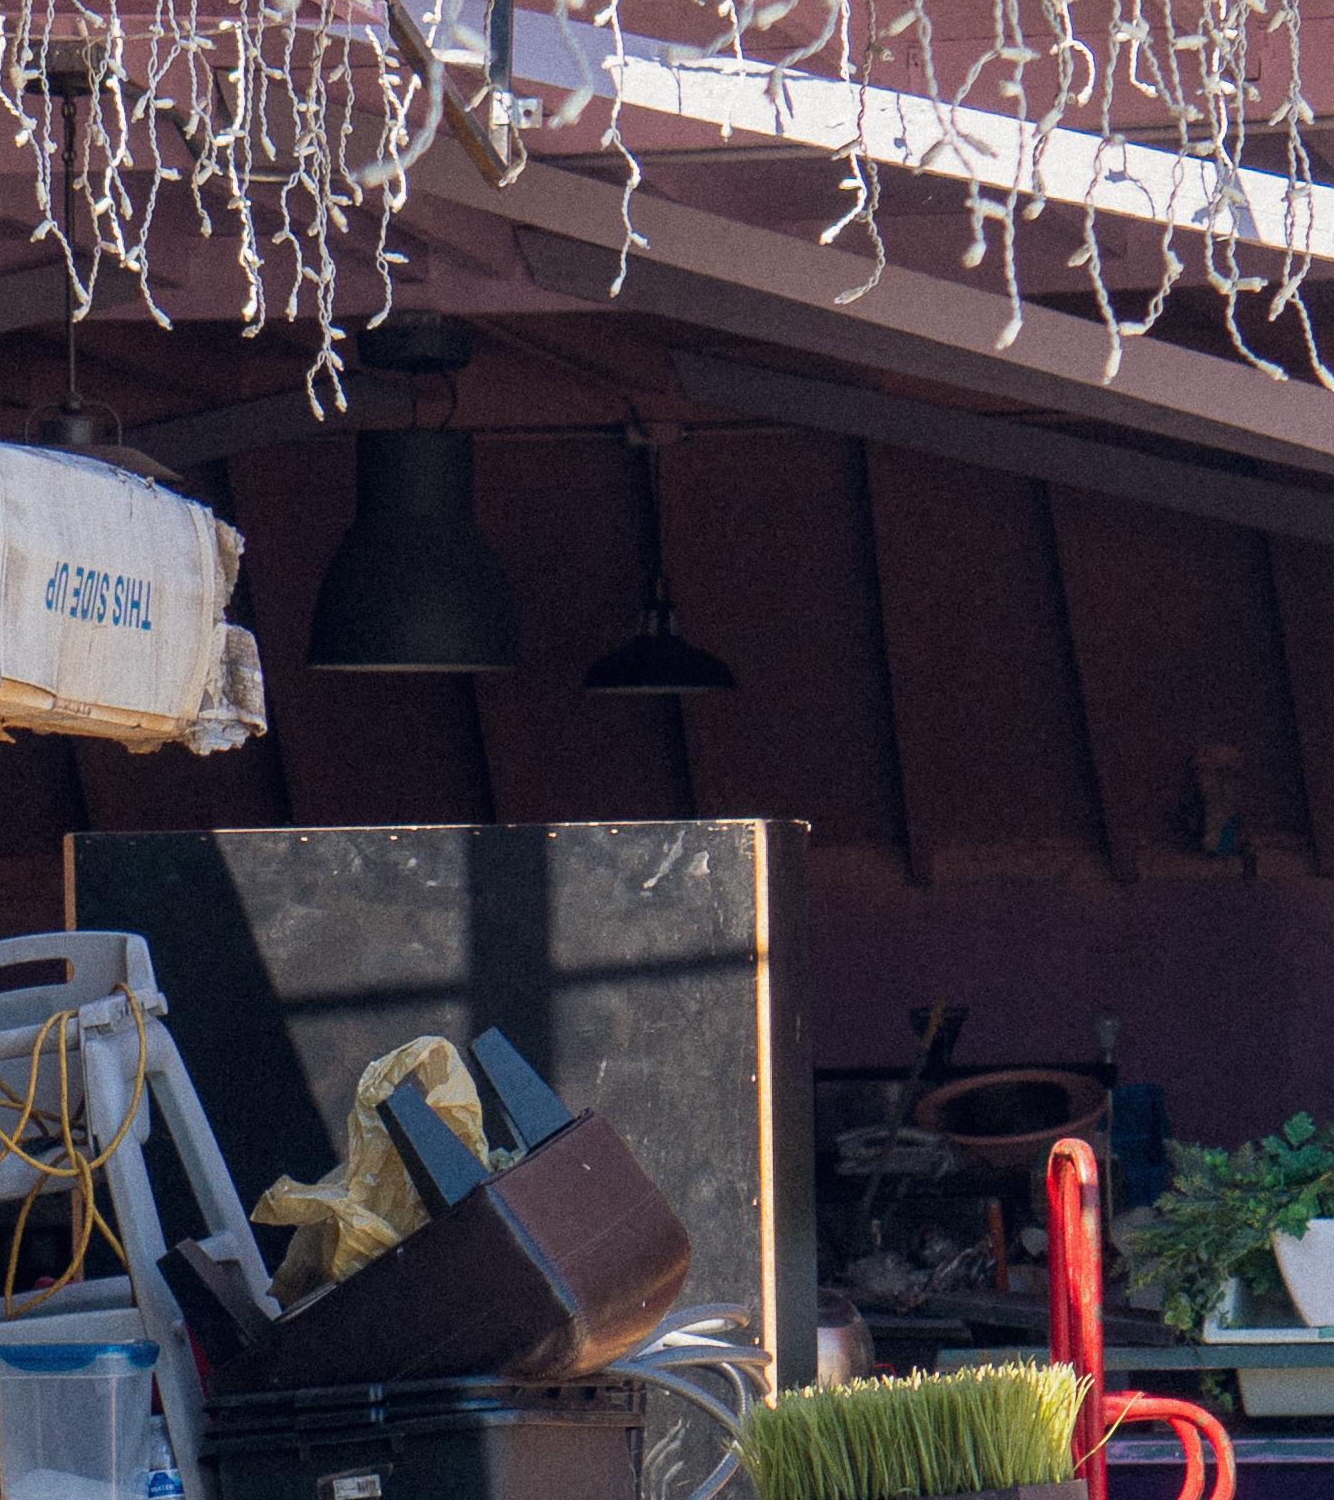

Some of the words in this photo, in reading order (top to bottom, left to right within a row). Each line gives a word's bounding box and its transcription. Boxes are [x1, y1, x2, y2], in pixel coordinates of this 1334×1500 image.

[45, 561, 69, 614] UP
[69, 567, 110, 623] SIDE
[113, 575, 151, 630] THIS
